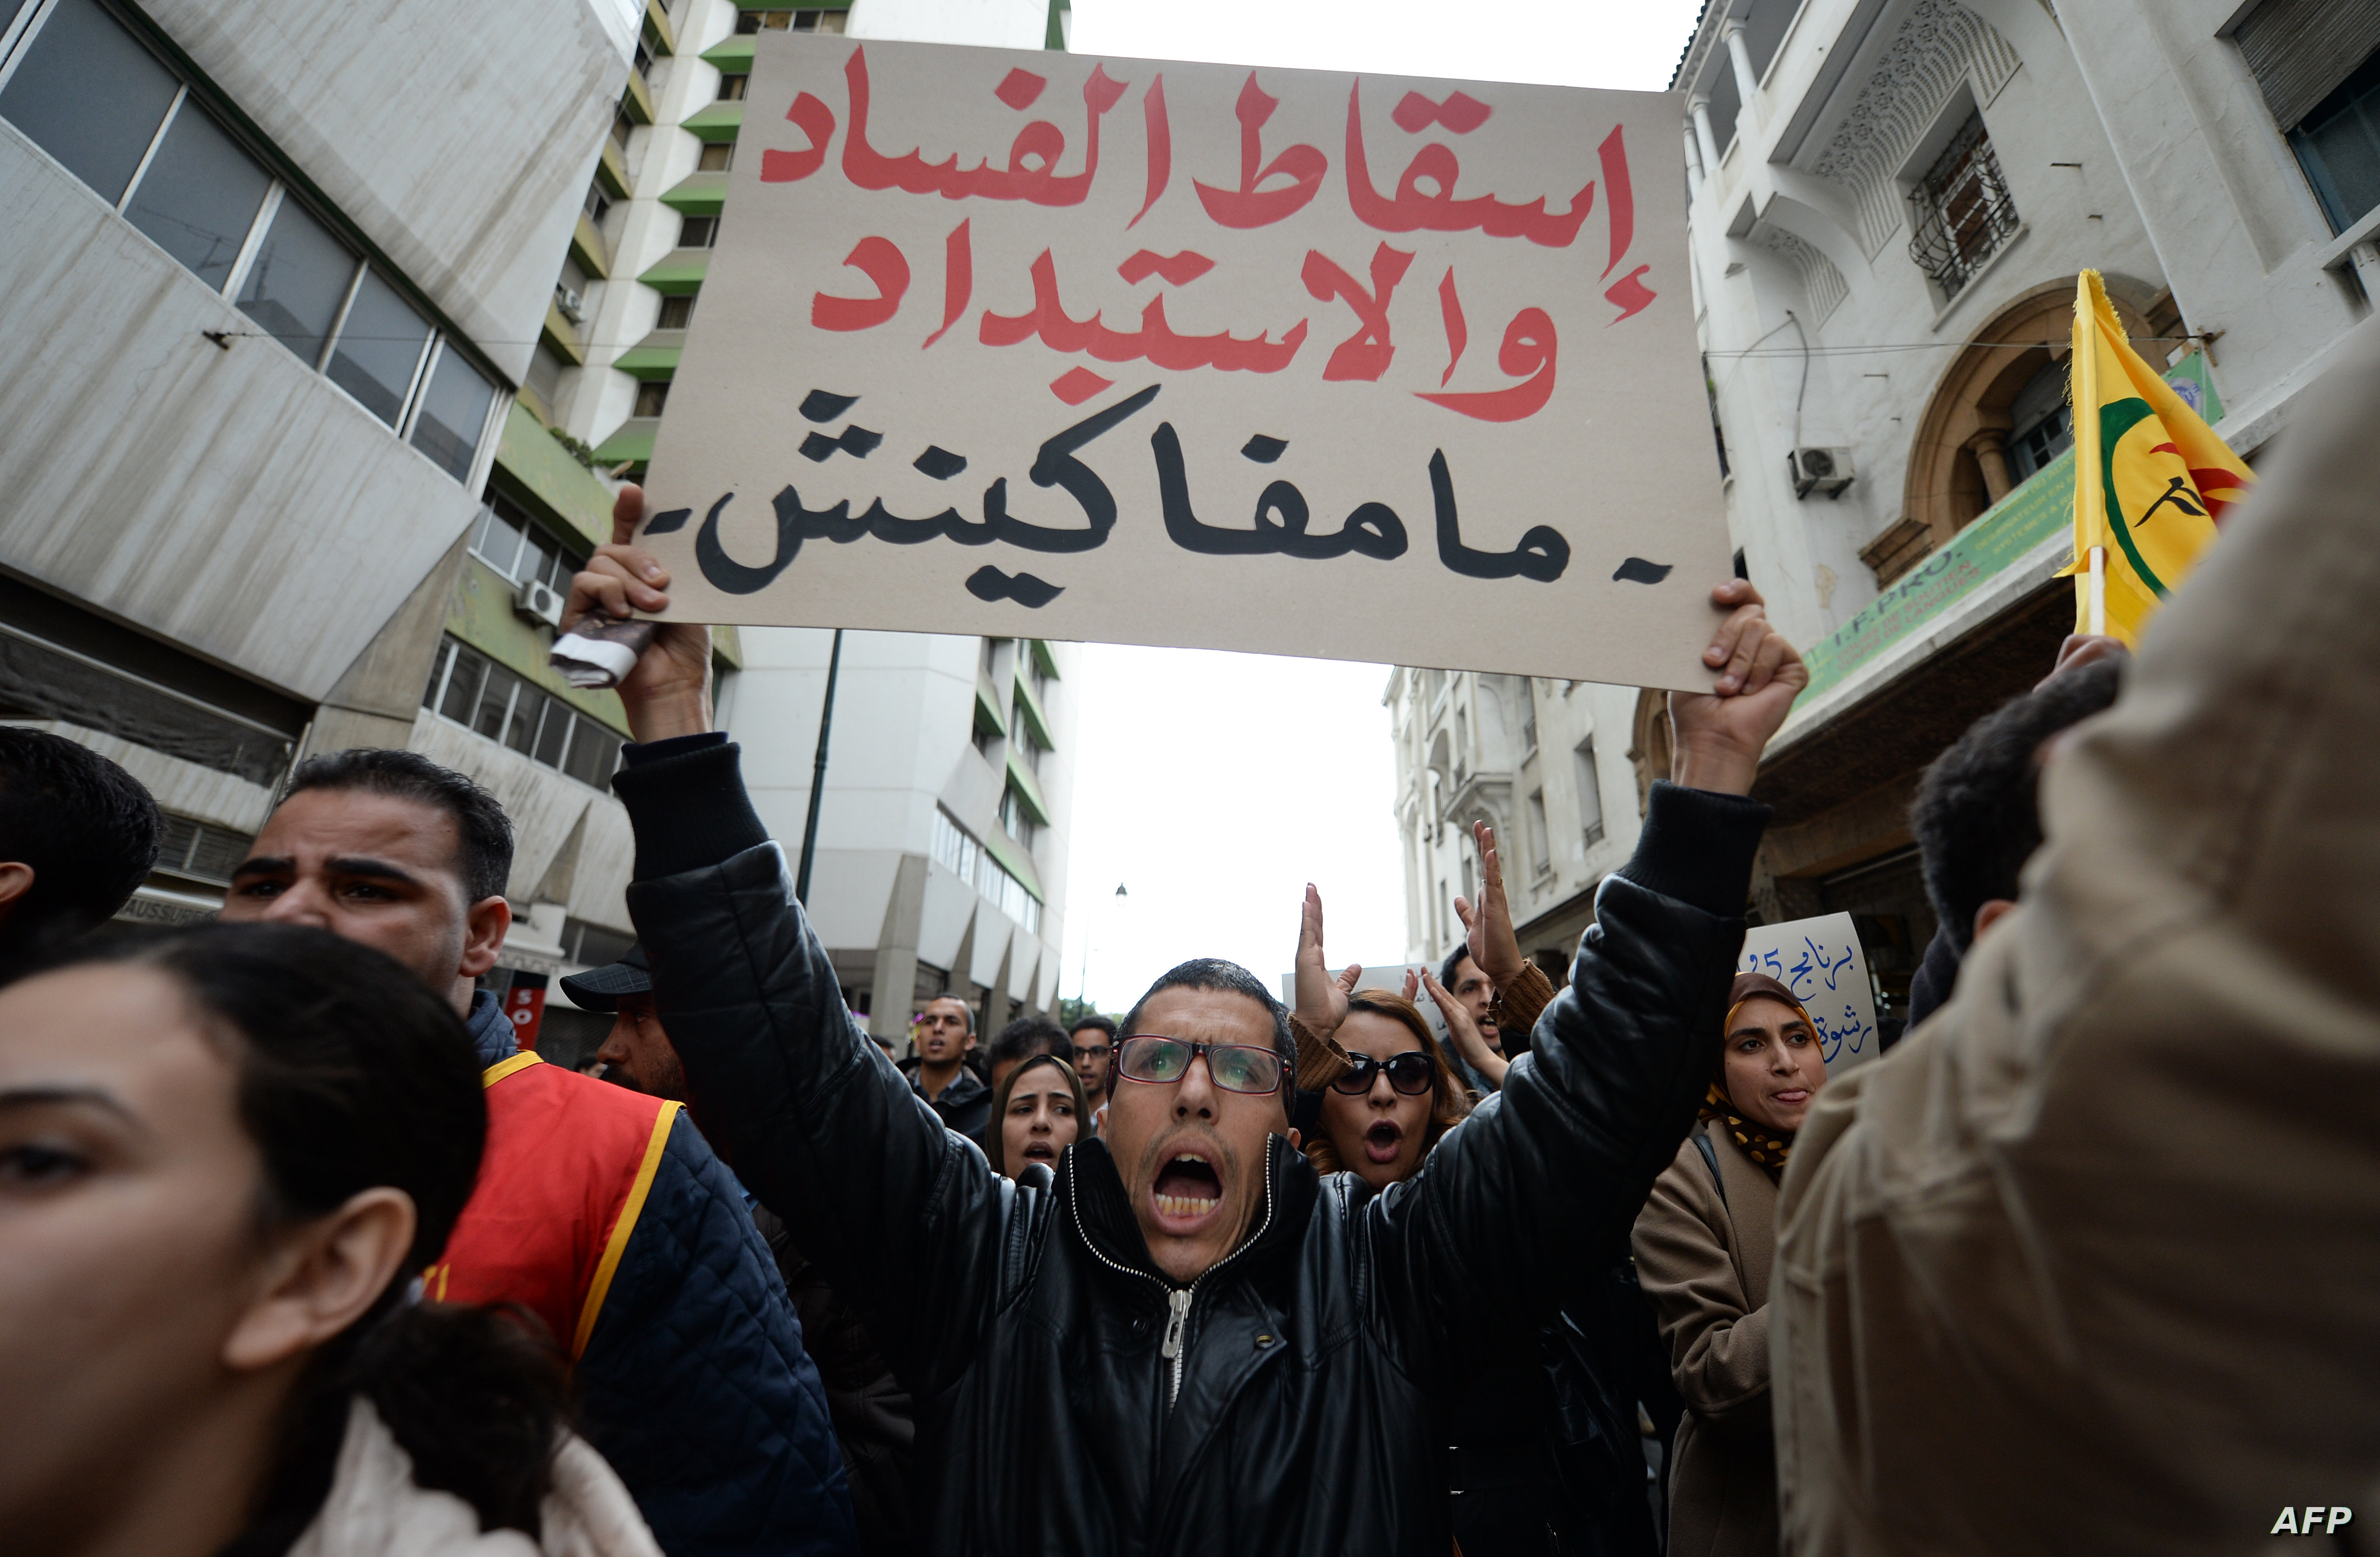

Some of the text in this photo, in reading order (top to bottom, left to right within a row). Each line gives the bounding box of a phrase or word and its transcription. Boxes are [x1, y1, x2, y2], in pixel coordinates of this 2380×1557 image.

[760, 44, 1658, 327] إسقاط الفساد
[812, 219, 1557, 422] والاستبداد
[1903, 560, 1971, 614] SOUTIEN
